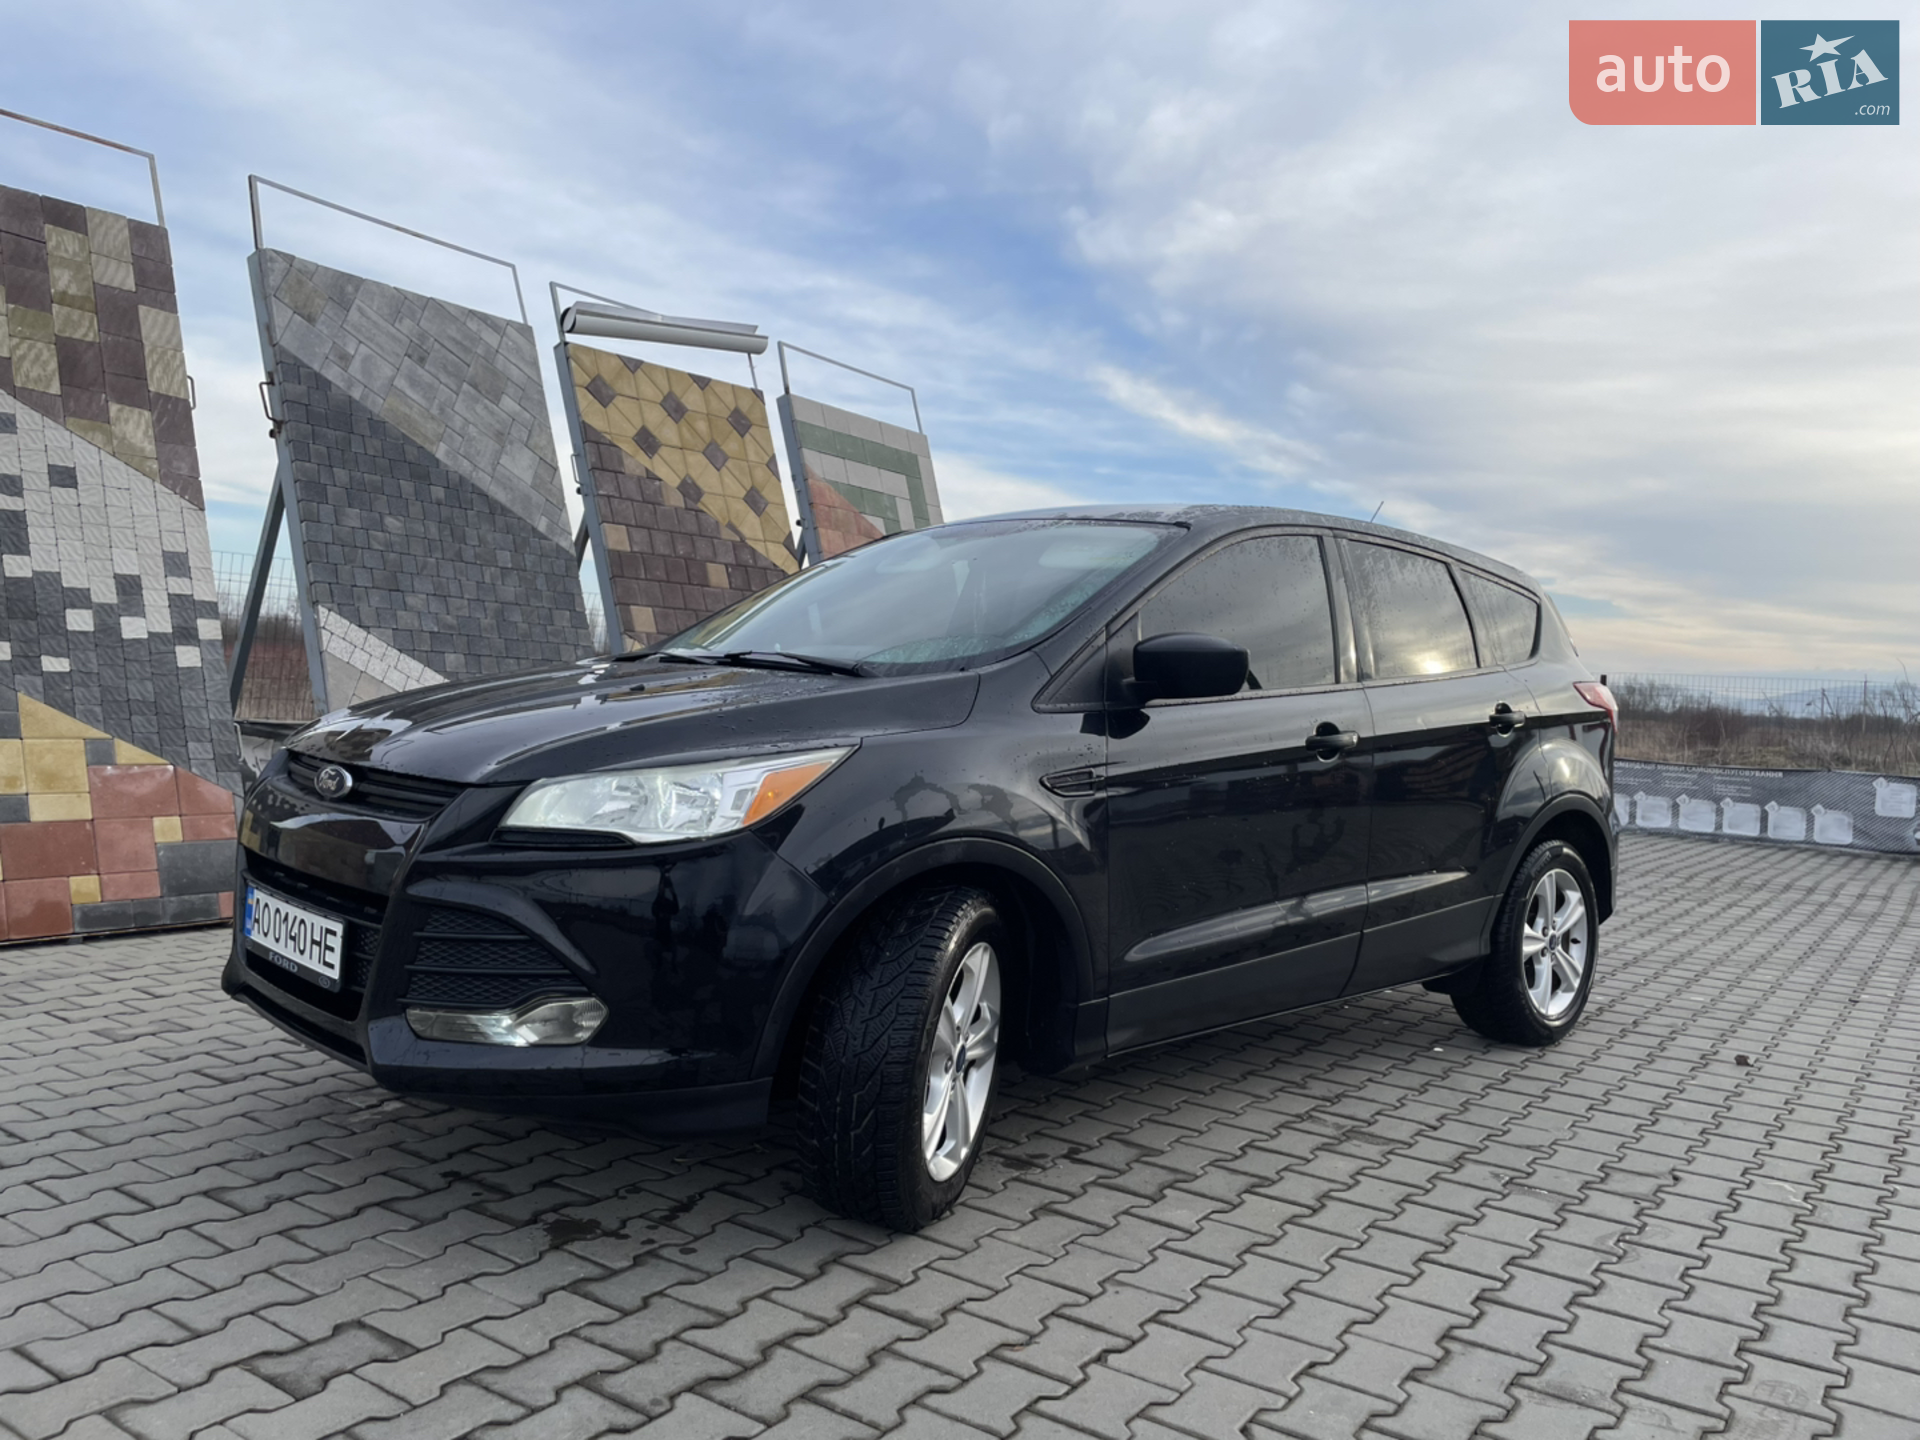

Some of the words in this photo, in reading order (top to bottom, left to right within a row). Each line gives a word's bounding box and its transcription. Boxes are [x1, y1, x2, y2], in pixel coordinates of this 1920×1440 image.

[252, 897, 272, 938] AO
[273, 907, 307, 956] 0140
[309, 922, 338, 971] HE
[268, 951, 299, 974] FORD
